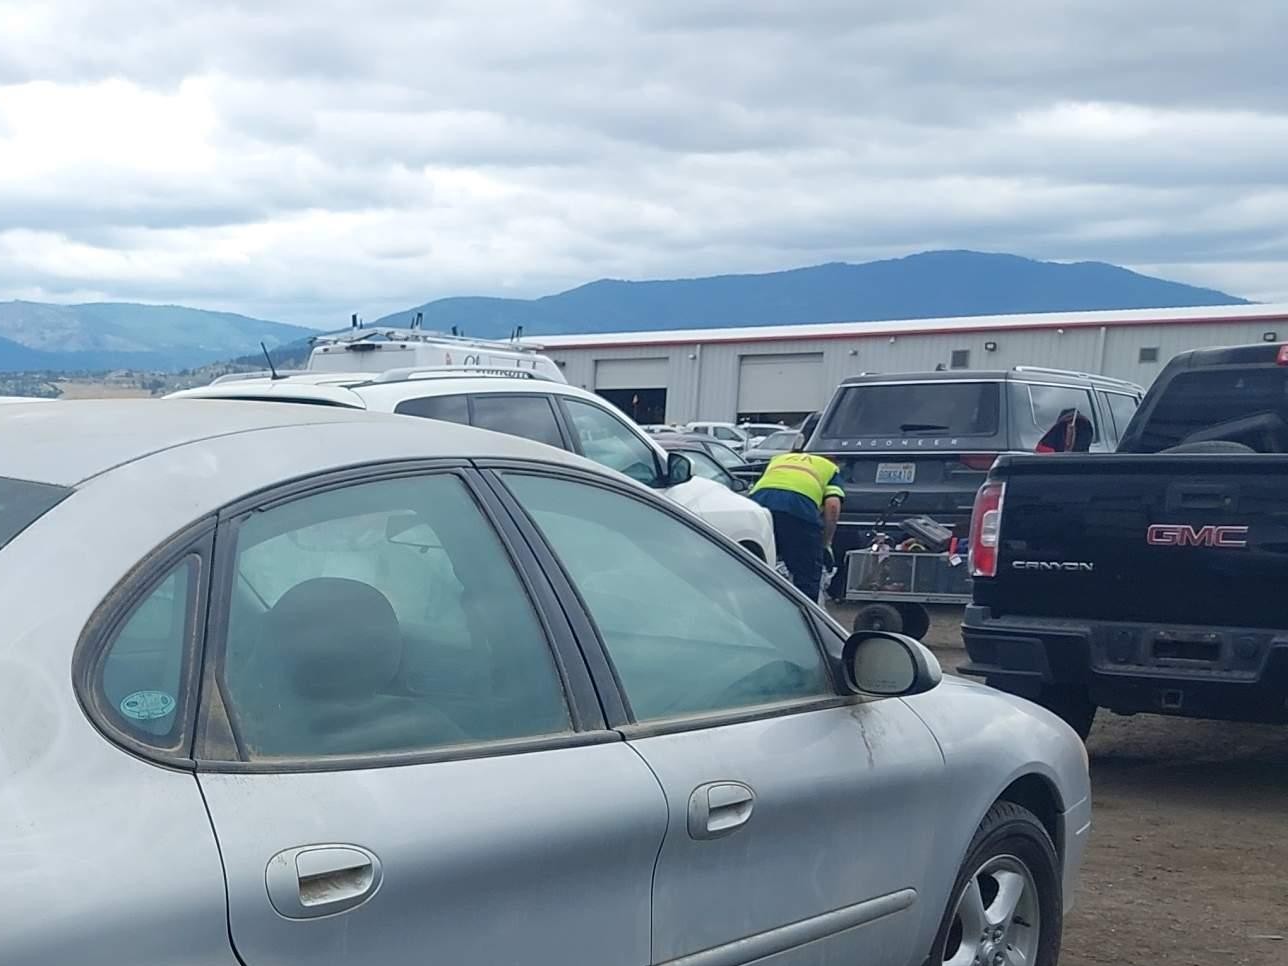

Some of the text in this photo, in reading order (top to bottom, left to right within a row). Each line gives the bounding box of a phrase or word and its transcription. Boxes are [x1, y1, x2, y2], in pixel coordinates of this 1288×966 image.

[841, 438, 958, 447] WAGONEER
[1147, 523, 1249, 547] GMC
[1012, 560, 1094, 571] CANYON
